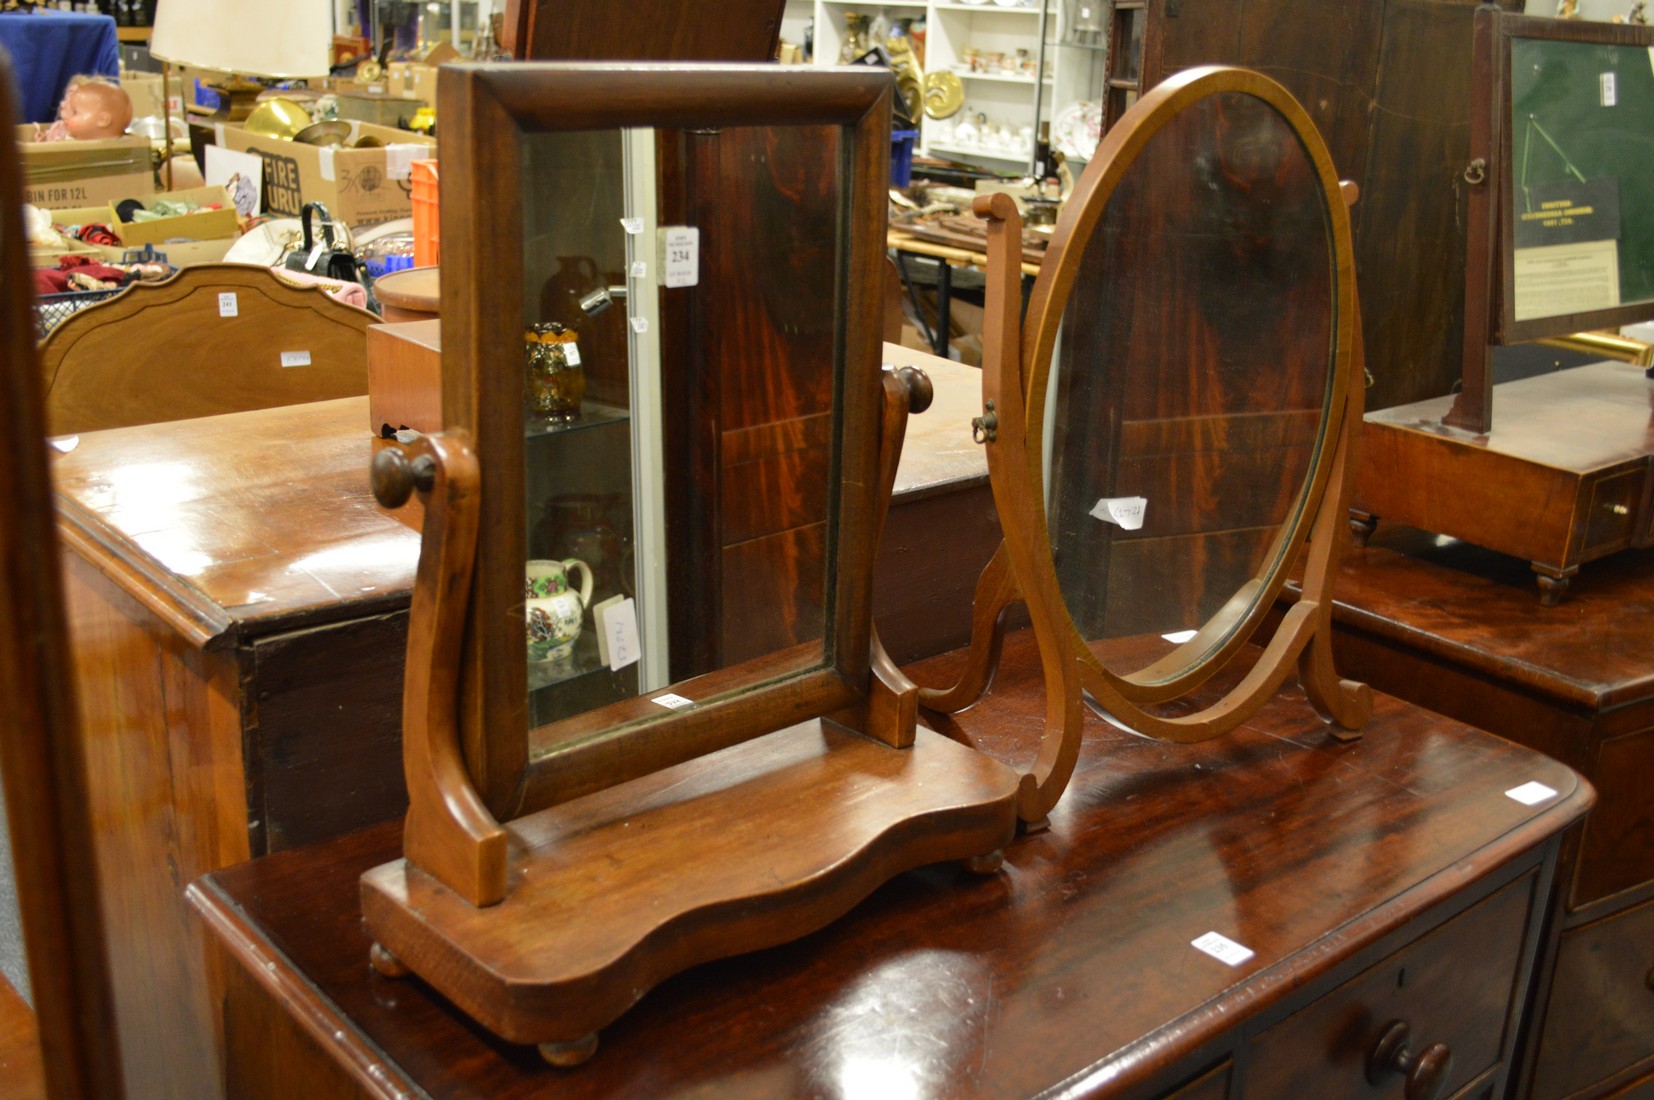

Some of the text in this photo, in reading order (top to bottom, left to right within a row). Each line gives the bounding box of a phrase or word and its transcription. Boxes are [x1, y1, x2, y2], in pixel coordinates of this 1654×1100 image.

[263, 157, 297, 190] FIRE
[47, 189, 67, 201] FOR
[70, 187, 88, 200] 12L
[672, 251, 689, 263] 234
